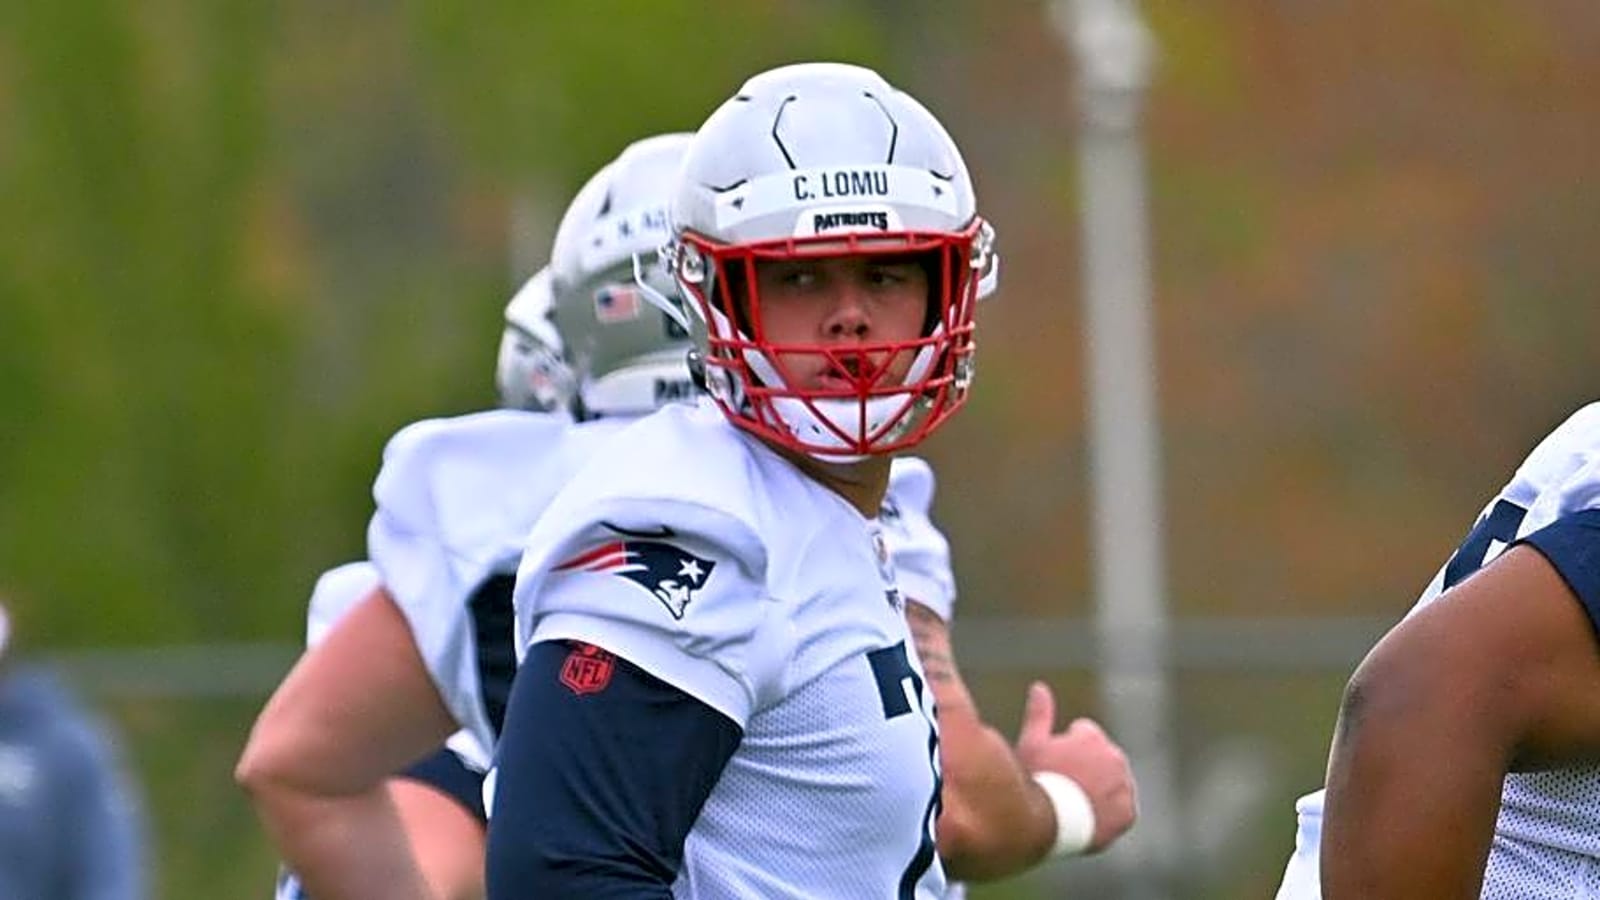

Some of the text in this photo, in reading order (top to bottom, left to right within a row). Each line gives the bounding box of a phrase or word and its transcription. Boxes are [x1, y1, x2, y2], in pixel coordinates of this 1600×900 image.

[794, 171, 888, 200] C. LOMU
[814, 211, 888, 232] PATRIOTS
[566, 658, 603, 686] NFL
